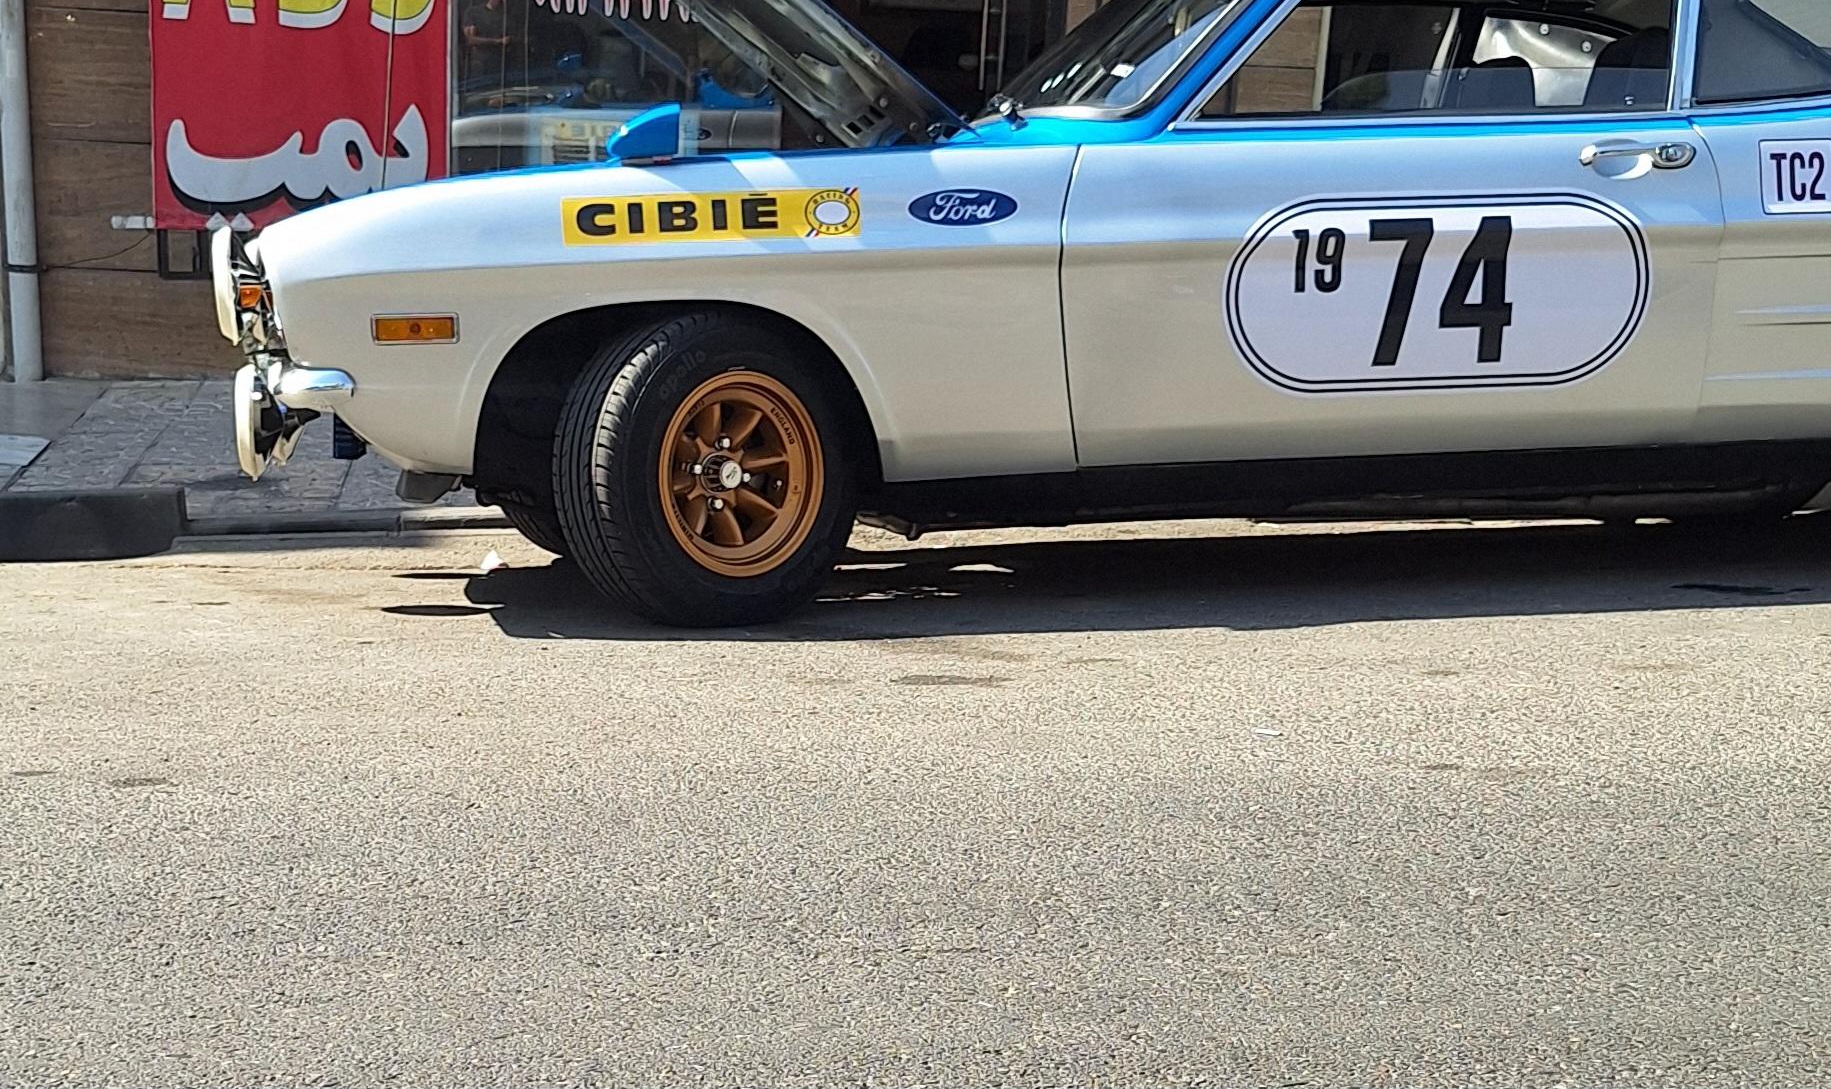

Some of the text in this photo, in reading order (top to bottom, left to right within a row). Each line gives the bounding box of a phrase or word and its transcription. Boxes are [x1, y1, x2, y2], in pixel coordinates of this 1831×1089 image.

[1769, 151, 1827, 203] TC2
[928, 192, 997, 222] Ford
[1291, 214, 1513, 367] 19 74
[770, 406, 796, 445] ENGLAND
